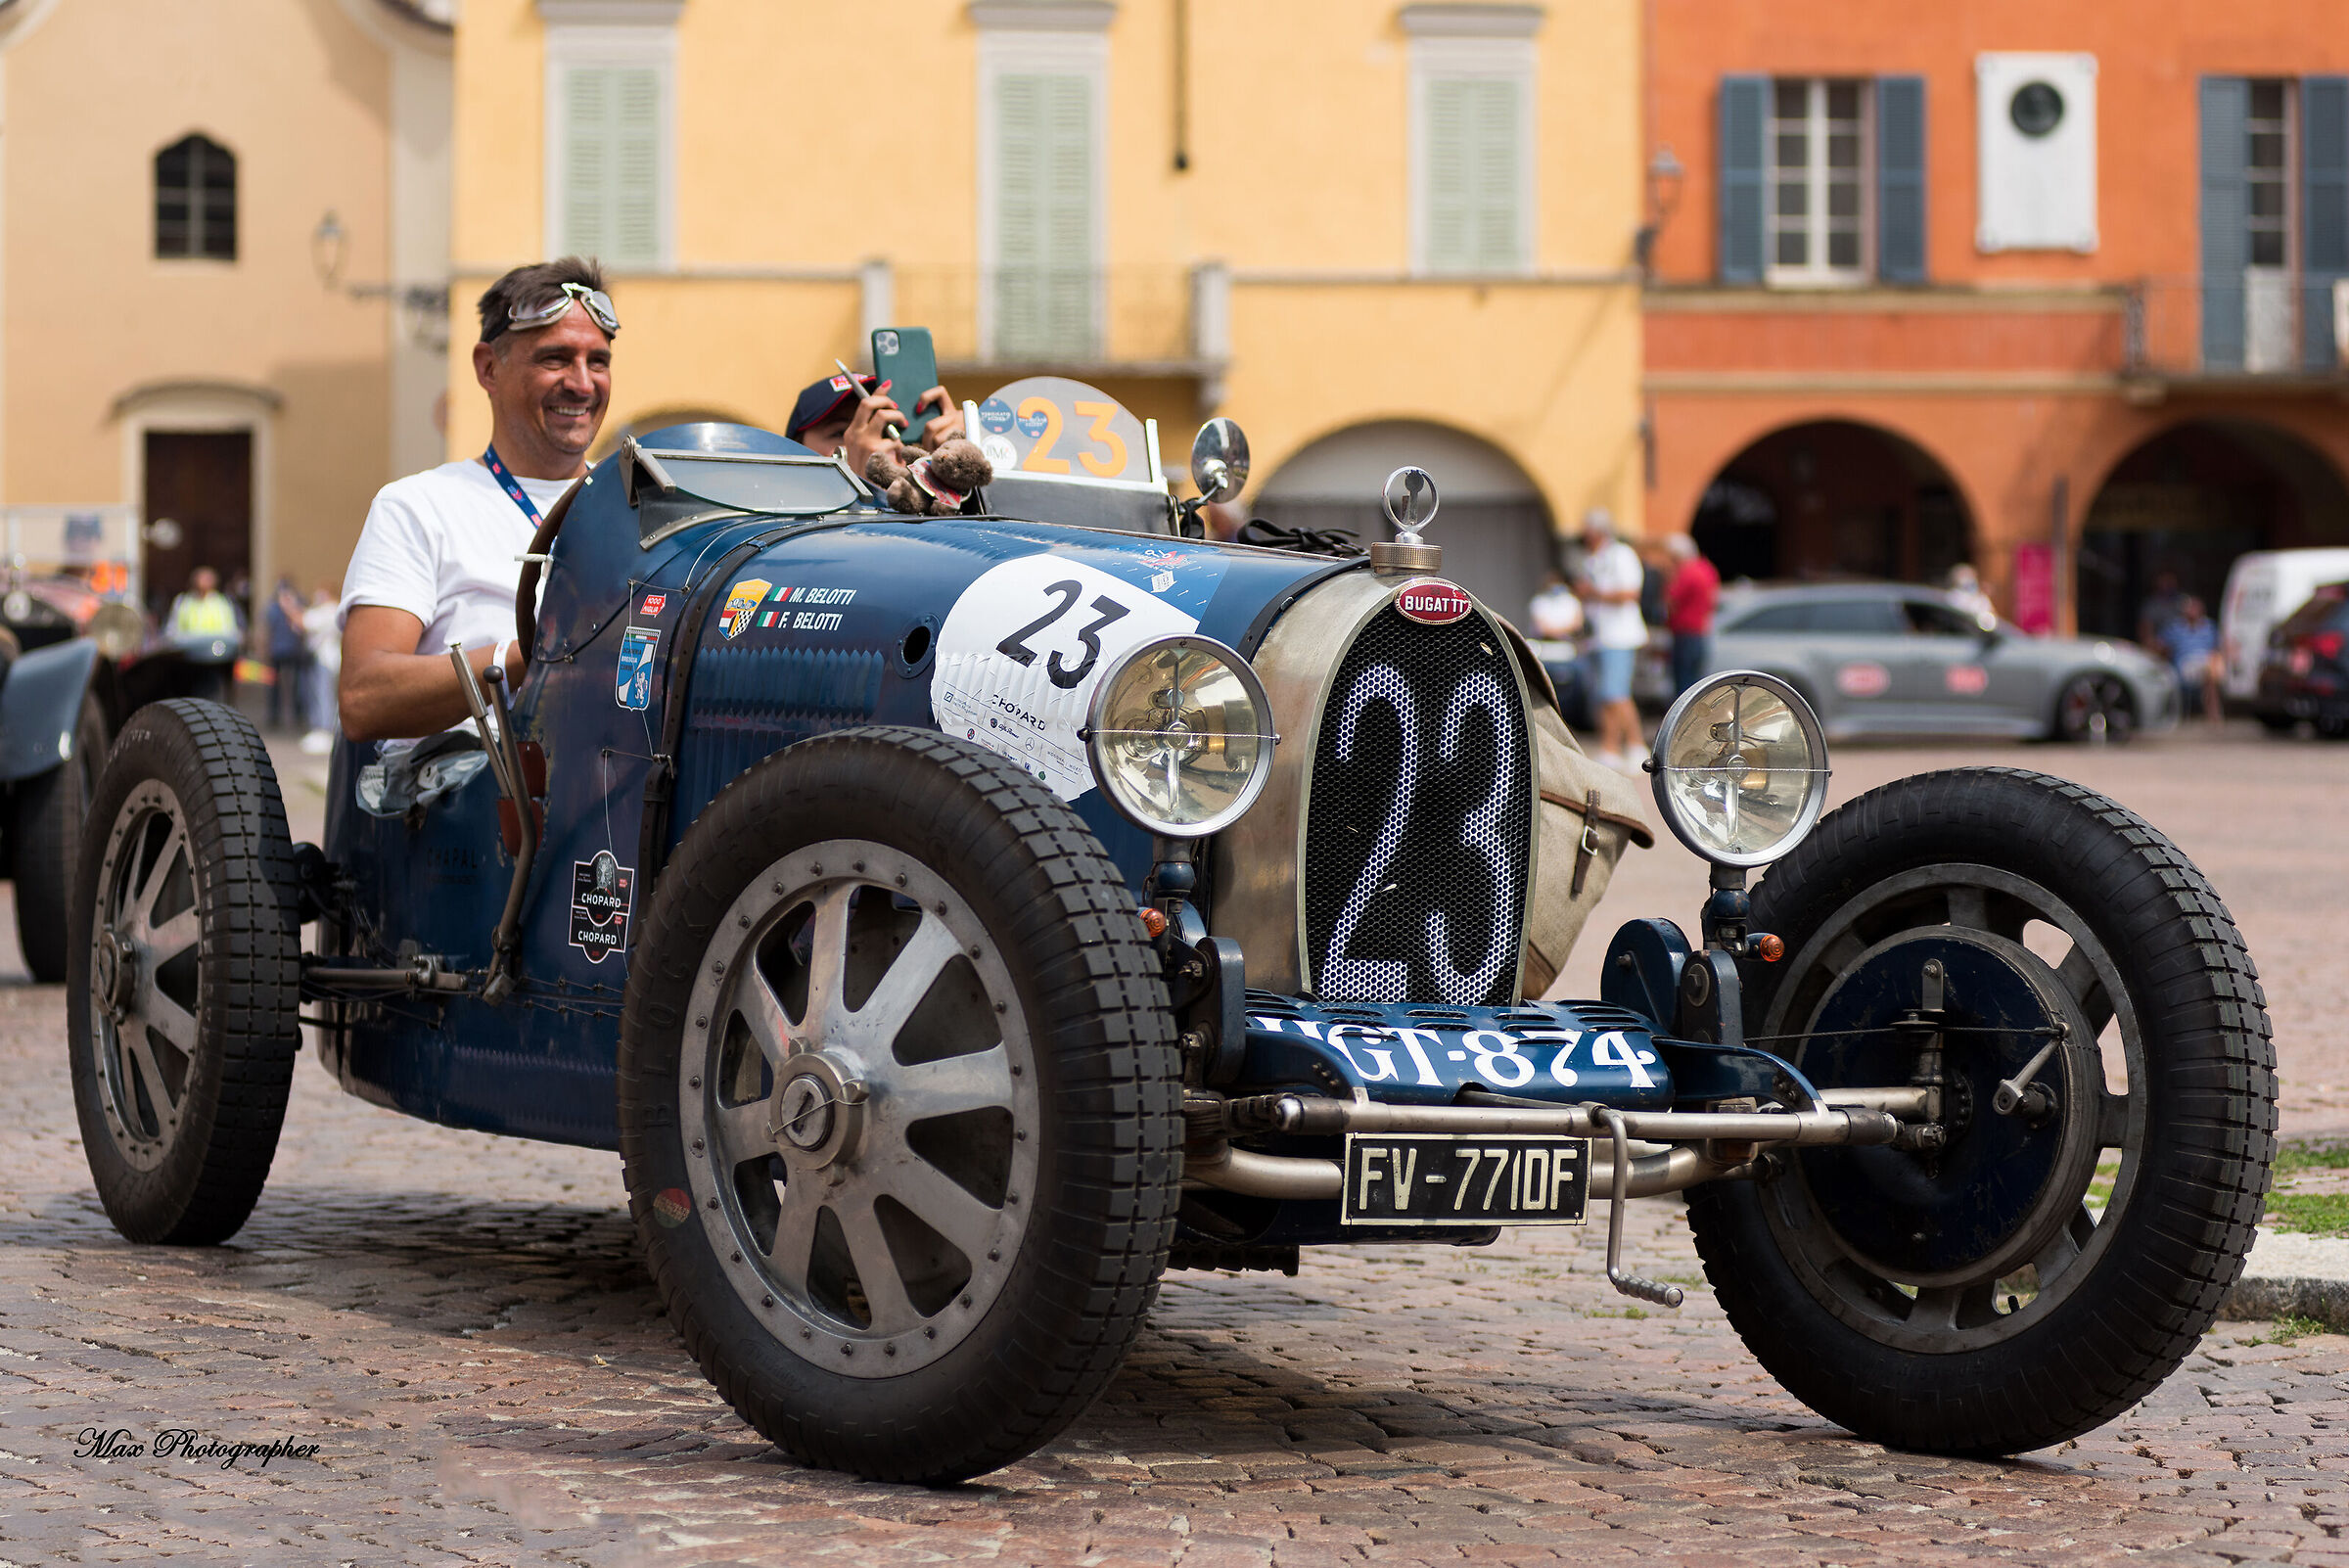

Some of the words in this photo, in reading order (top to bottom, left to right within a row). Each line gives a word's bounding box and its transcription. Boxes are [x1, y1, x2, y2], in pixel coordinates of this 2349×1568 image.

[1016, 396, 1128, 479] 23
[789, 587, 806, 604] M.
[804, 589, 856, 605] BELOTTI
[1405, 595, 1464, 613] BUGATTI
[777, 612, 791, 628] F.
[792, 612, 843, 631] BELOTTI
[995, 579, 1131, 689] 23
[991, 694, 1046, 731] CHOPARD
[1320, 663, 1516, 1006] 23
[581, 892, 622, 908] CHOPARD
[577, 930, 617, 945] CHOPARD
